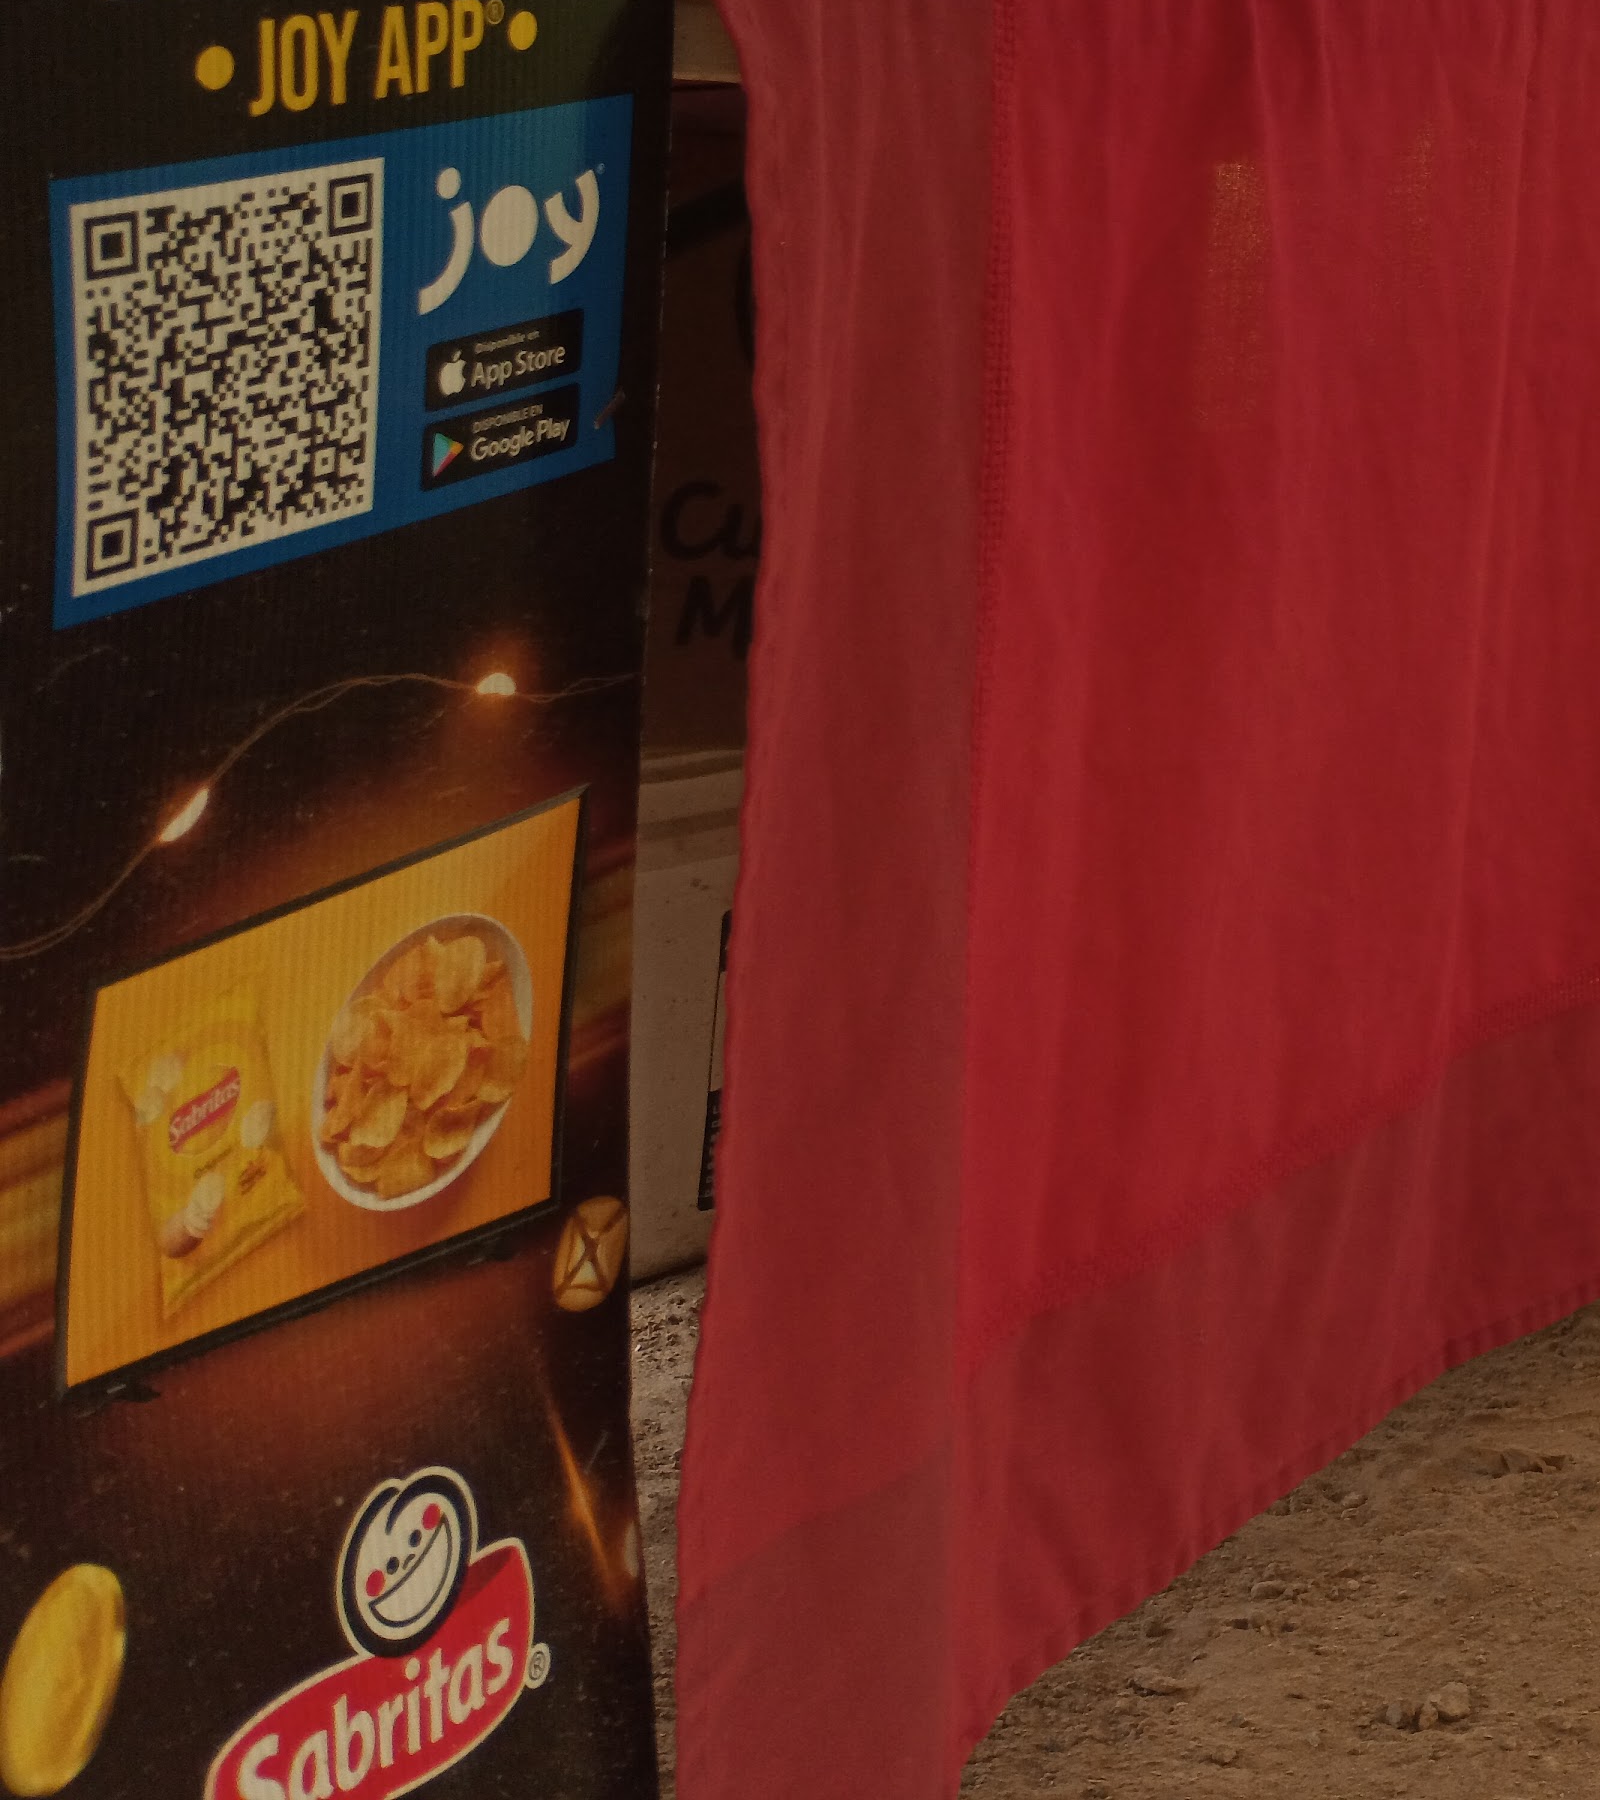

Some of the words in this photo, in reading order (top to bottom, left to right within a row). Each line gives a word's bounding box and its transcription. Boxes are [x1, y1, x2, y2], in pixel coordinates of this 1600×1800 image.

[249, 10, 359, 117] JOY
[418, 166, 600, 317] joy
[470, 355, 513, 389] App
[514, 344, 567, 377] Store
[470, 426, 535, 463] Google
[535, 415, 572, 446] Play
[234, 1615, 515, 1800] Sabritas
